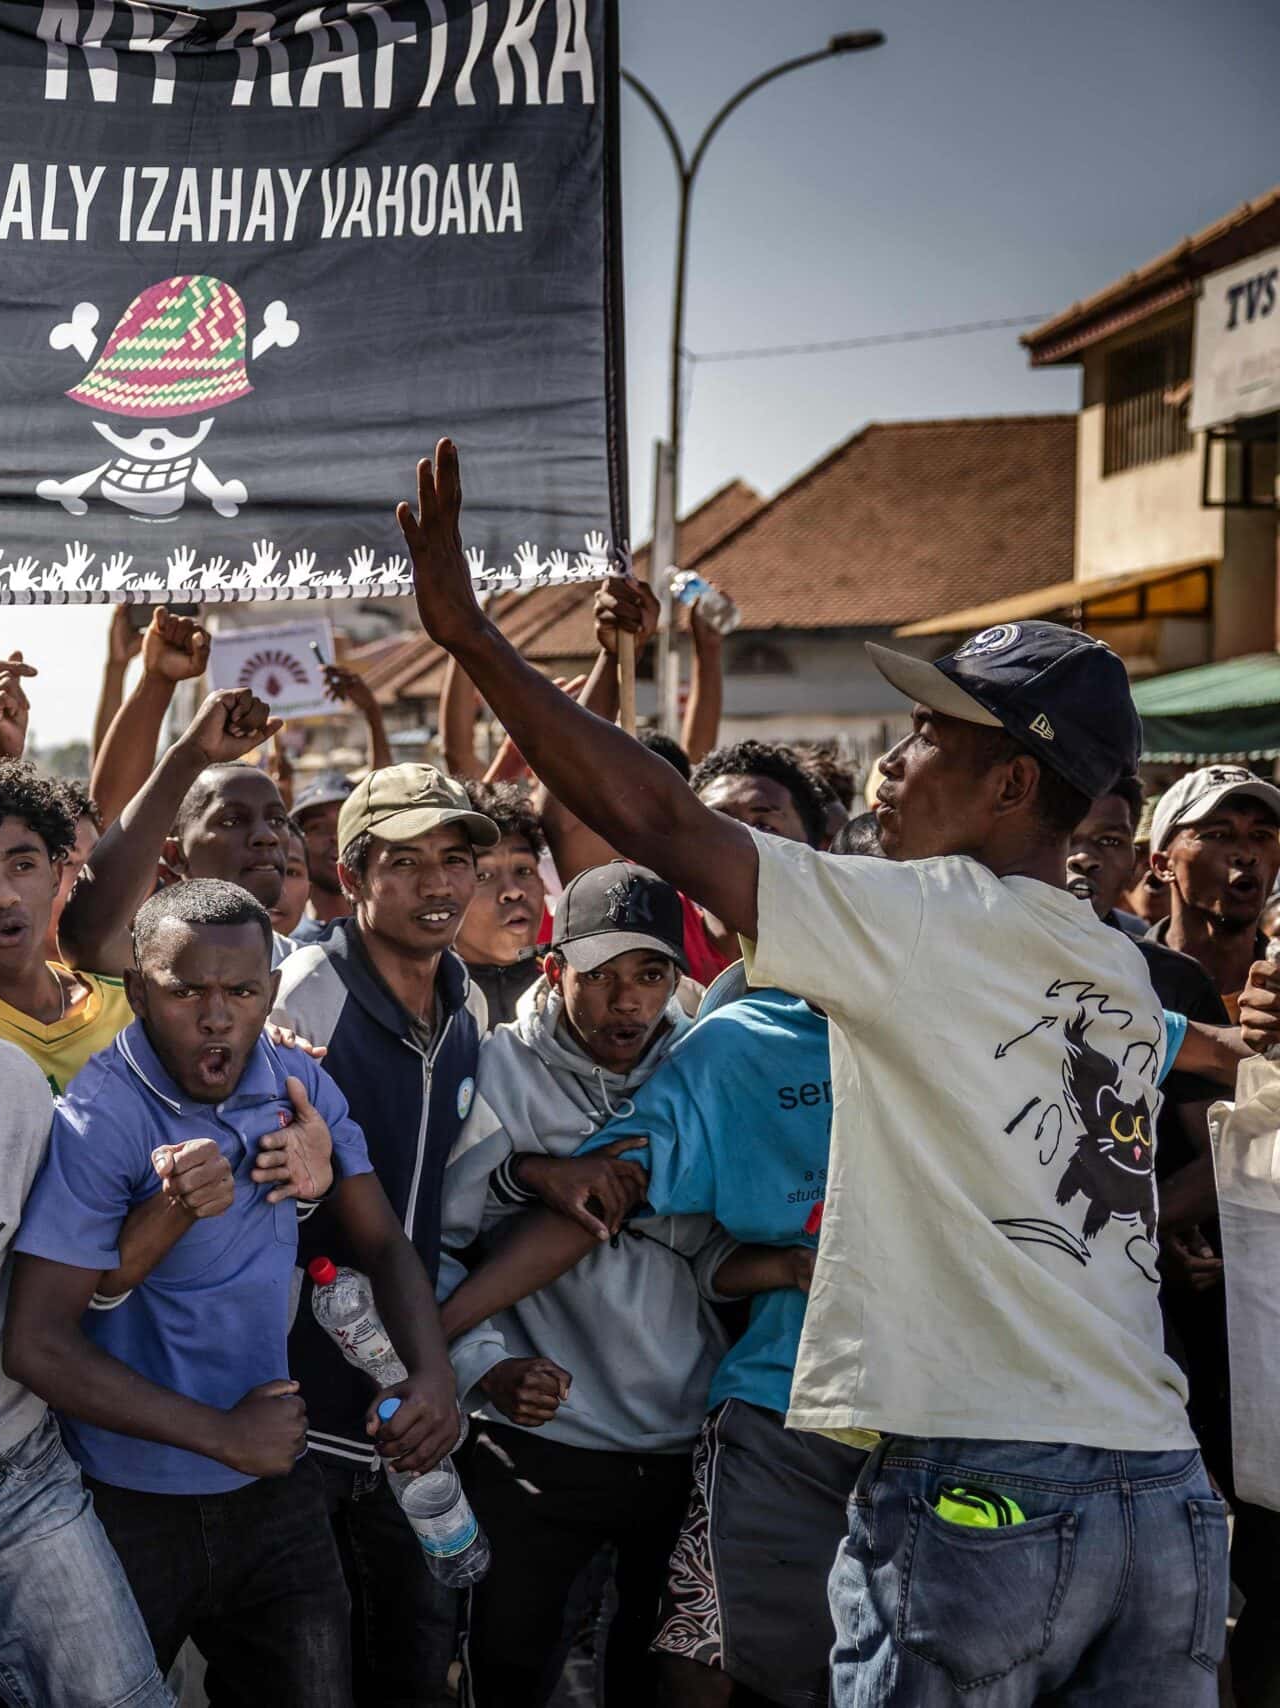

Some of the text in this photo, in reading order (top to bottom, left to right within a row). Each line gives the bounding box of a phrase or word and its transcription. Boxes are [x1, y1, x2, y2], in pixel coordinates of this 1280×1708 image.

[119, 165, 313, 243] IZAHAY
[320, 162, 524, 239] VAHOAKA
[1226, 268, 1278, 331] TVS
